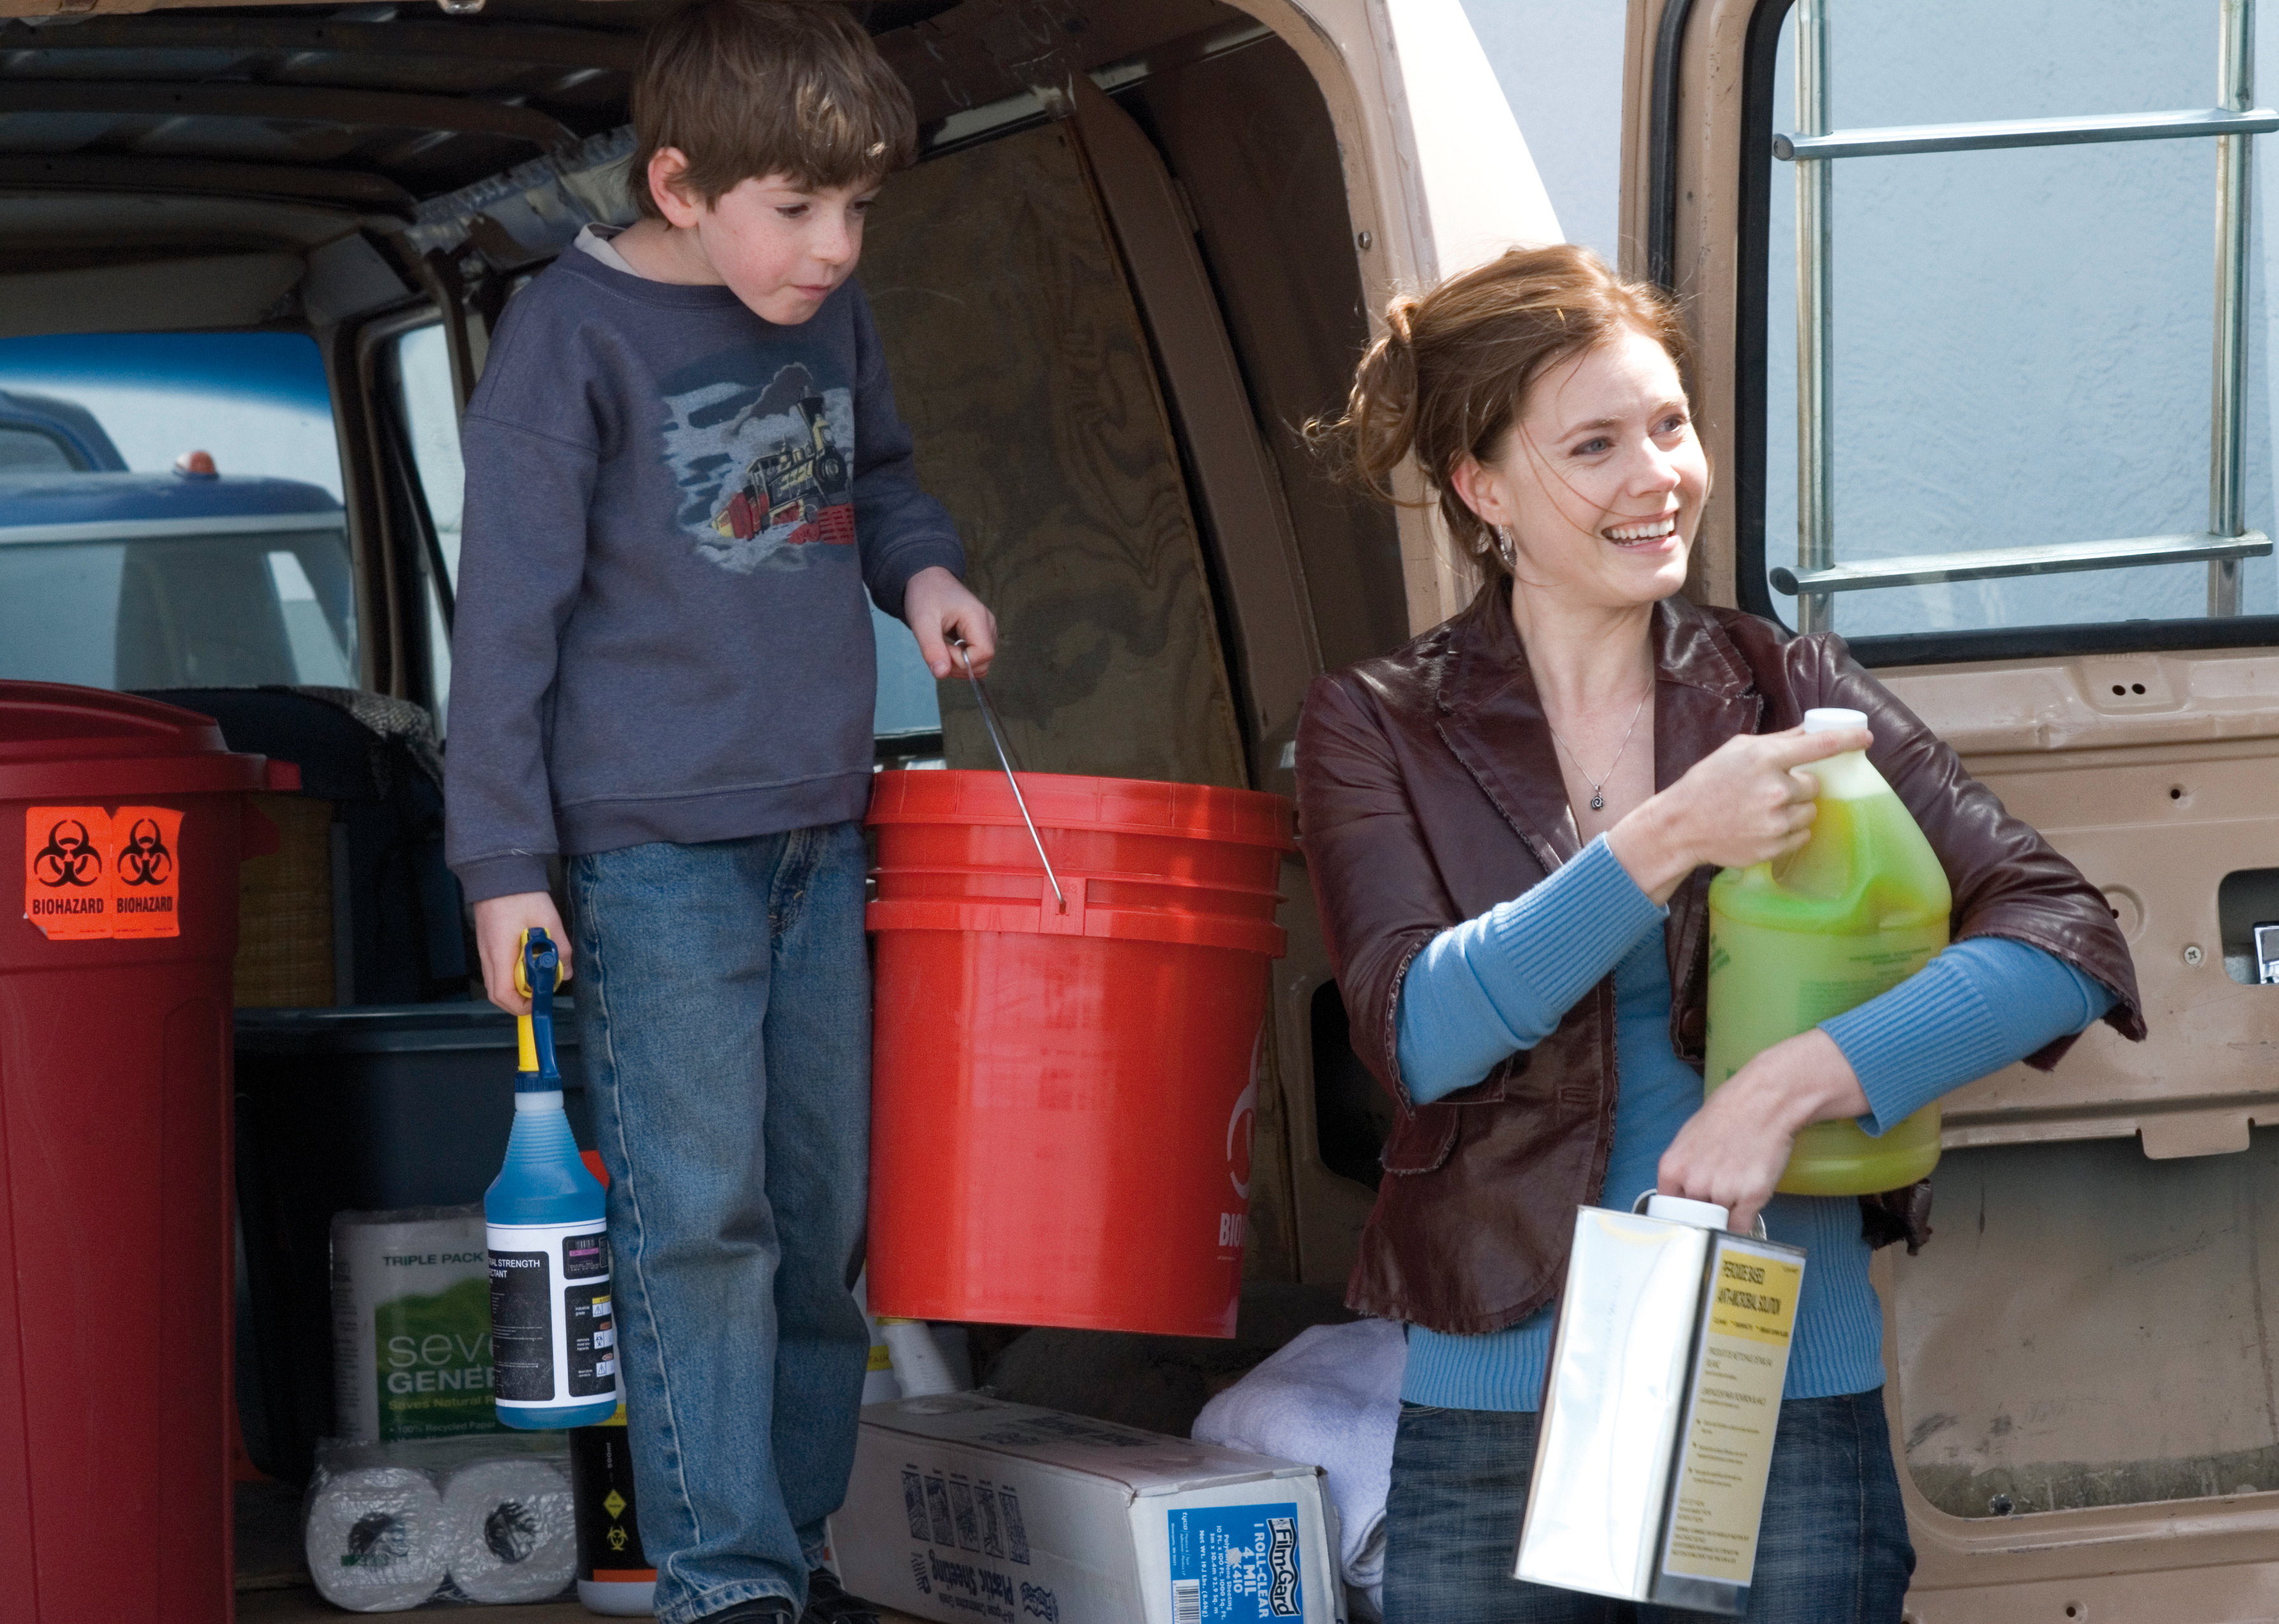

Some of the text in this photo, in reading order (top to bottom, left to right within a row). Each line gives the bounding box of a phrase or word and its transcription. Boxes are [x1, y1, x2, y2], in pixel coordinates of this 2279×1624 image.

[32, 898, 104, 915] BIOHAZARD
[117, 896, 173, 914] BIOHAZARD
[382, 1252, 484, 1266] TRIPLE PACK
[498, 1259, 541, 1268] STRENGTH
[489, 1268, 508, 1278] ECTANT
[389, 1398, 430, 1411] Saves
[434, 1396, 481, 1408] Natural
[425, 1422, 467, 1432] Recycled
[469, 1420, 495, 1430] Paper
[928, 1549, 1014, 1606] Plastic Sheeting
[1232, 1561, 1244, 1593] K410
[1242, 1546, 1257, 1596] 4 MIL
[1254, 1532, 1269, 1618] ROLL-CLEAR
[1274, 1529, 1296, 1615] Film-Gard
